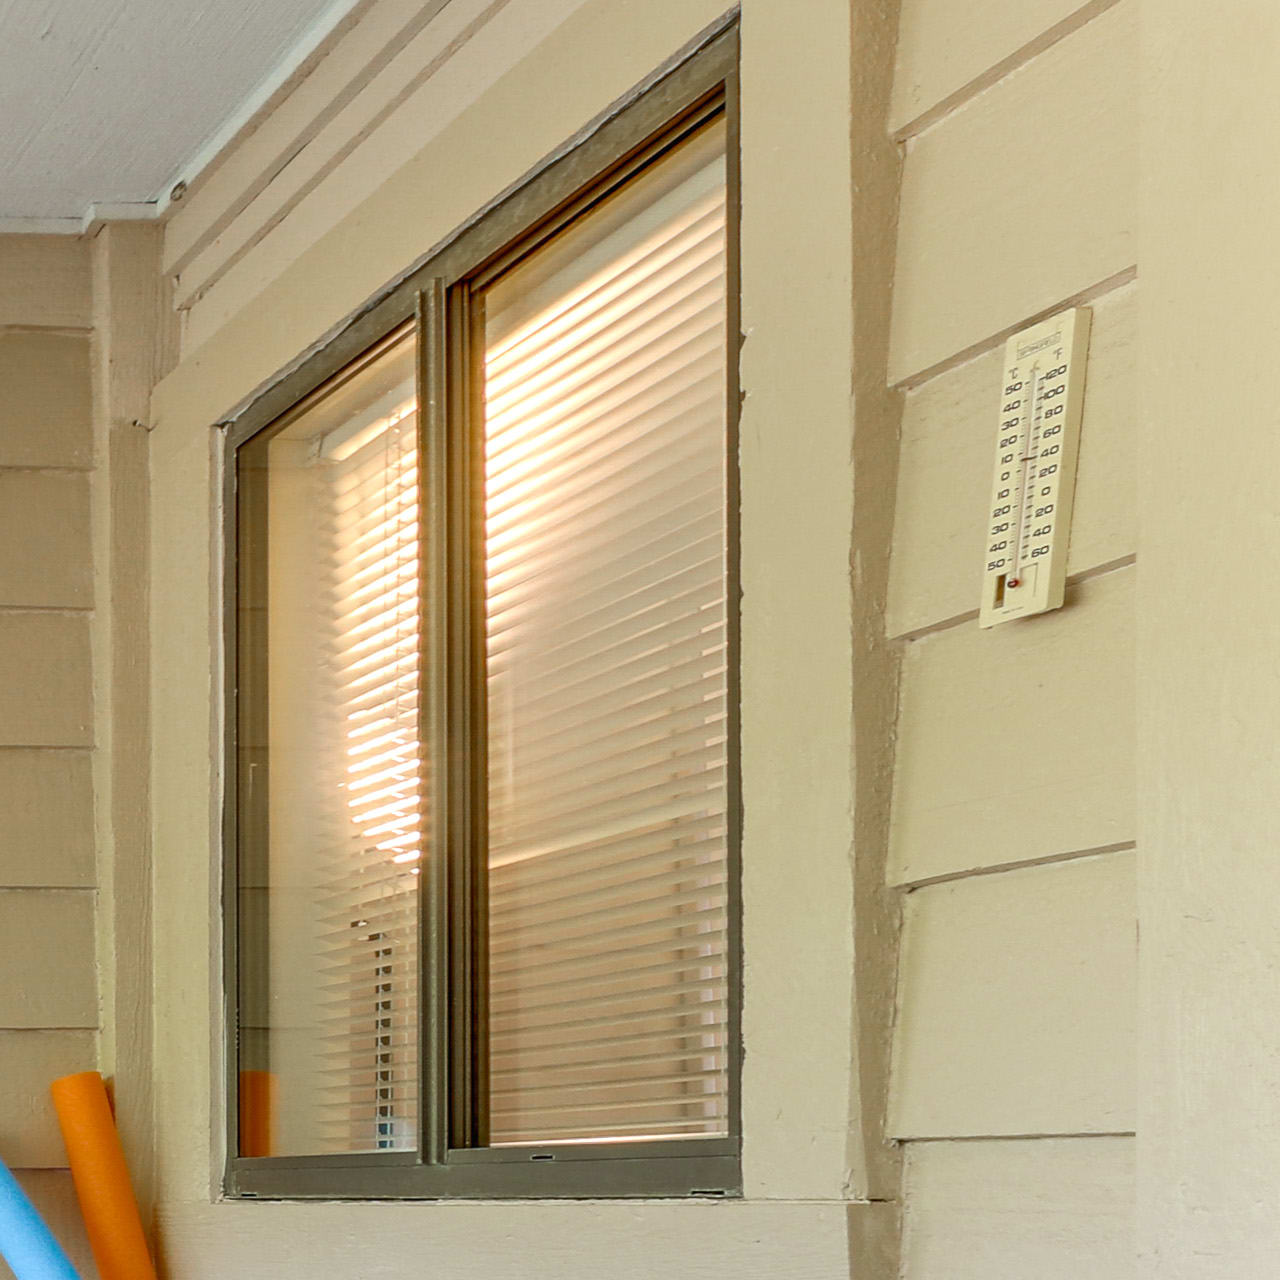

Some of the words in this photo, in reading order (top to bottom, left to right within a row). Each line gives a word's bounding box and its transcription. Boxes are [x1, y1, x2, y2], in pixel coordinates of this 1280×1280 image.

[1005, 382, 1022, 395] 50
[1003, 400, 1021, 412] 40
[1045, 405, 1063, 419] 80
[1001, 418, 1019, 431] 30
[1043, 425, 1061, 438] 60
[1000, 435, 1017, 449] 20
[1040, 445, 1059, 457] 40
[1001, 454, 1013, 464] 10
[1001, 472, 1010, 481] 0
[1039, 464, 1057, 478] 20
[998, 489, 1009, 500] 10
[1041, 486, 1050, 496] 0
[993, 505, 1010, 518] 20
[1035, 504, 1053, 517] 20
[992, 522, 1008, 535] 30
[1032, 525, 1051, 537] 40
[989, 541, 1007, 552] 40
[1031, 545, 1049, 558] 60
[988, 559, 1005, 571] 50
